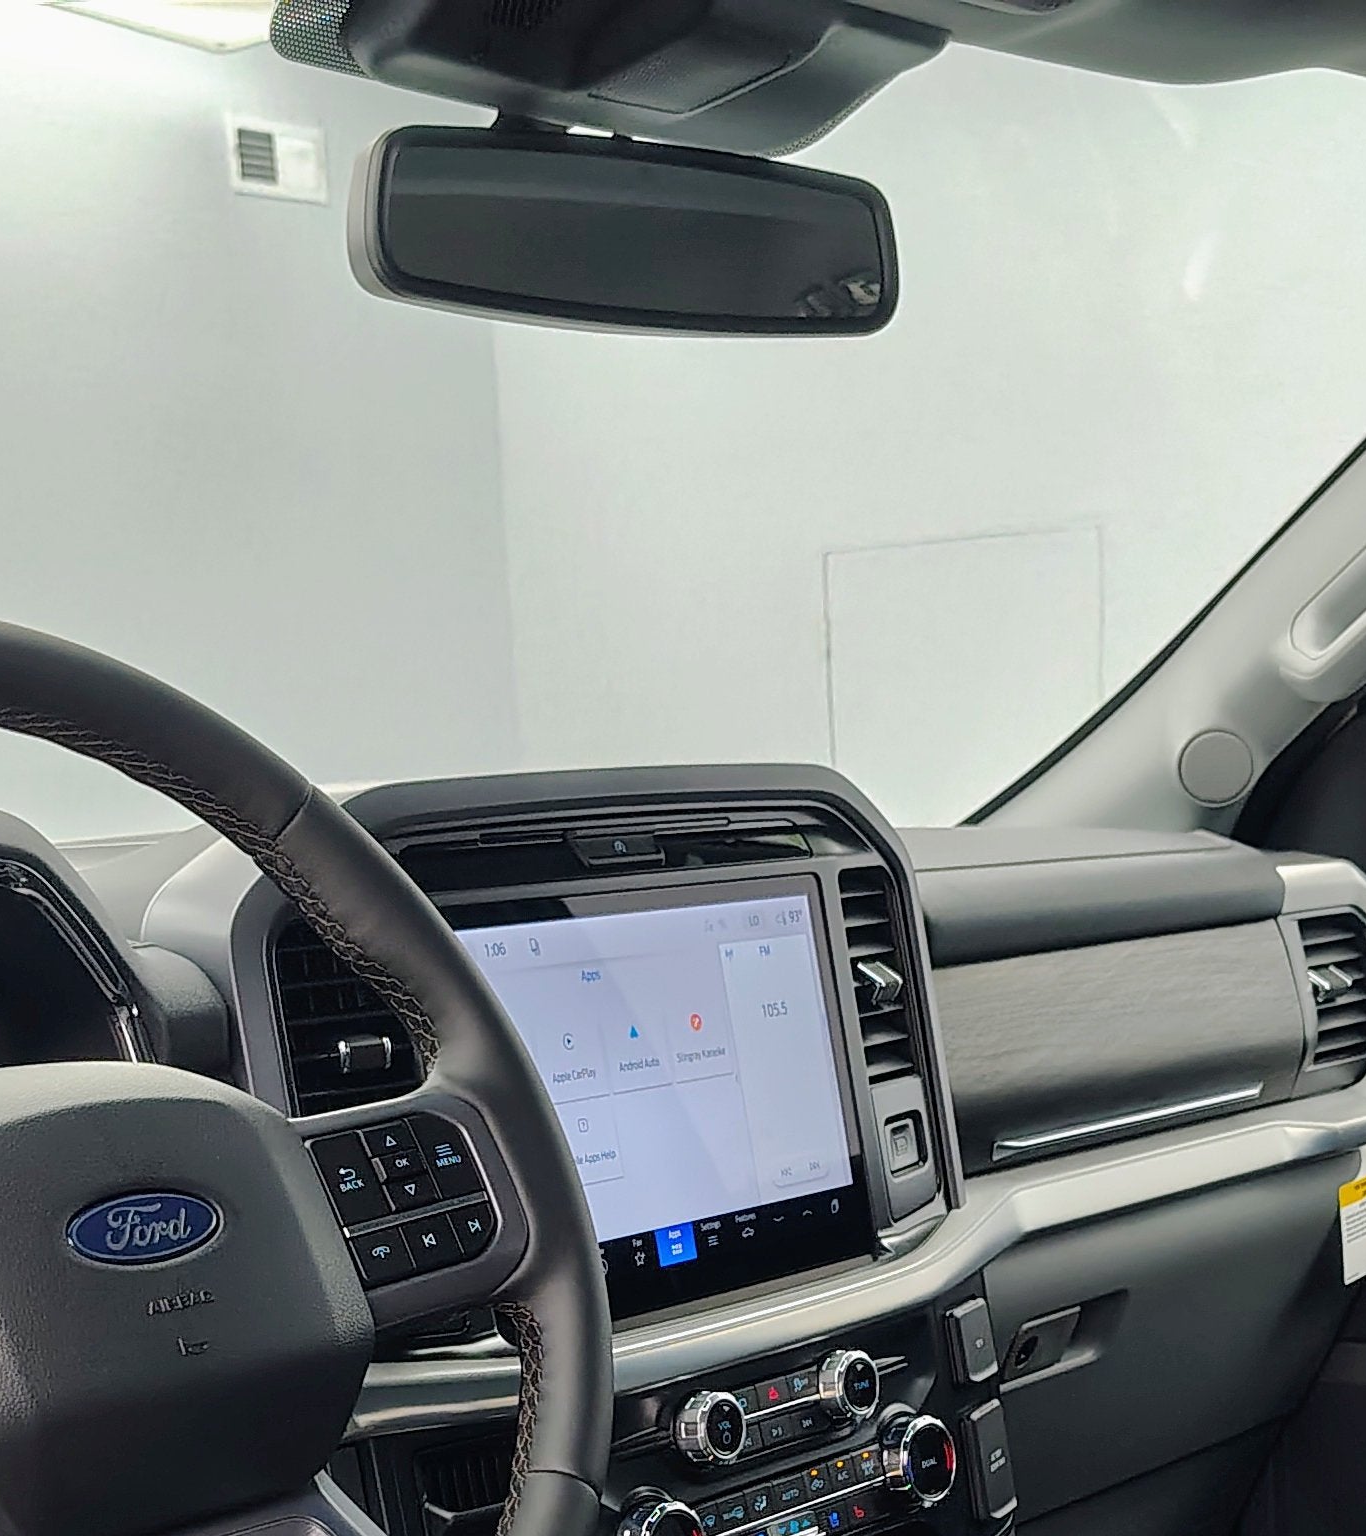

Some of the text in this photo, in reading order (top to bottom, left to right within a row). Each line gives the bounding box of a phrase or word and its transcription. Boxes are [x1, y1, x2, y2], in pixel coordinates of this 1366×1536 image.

[761, 1001, 788, 1018] 105.5
[395, 1157, 410, 1168] OK
[435, 1155, 462, 1168] MENU
[339, 1178, 365, 1193] BACK
[105, 1203, 192, 1251] Ford
